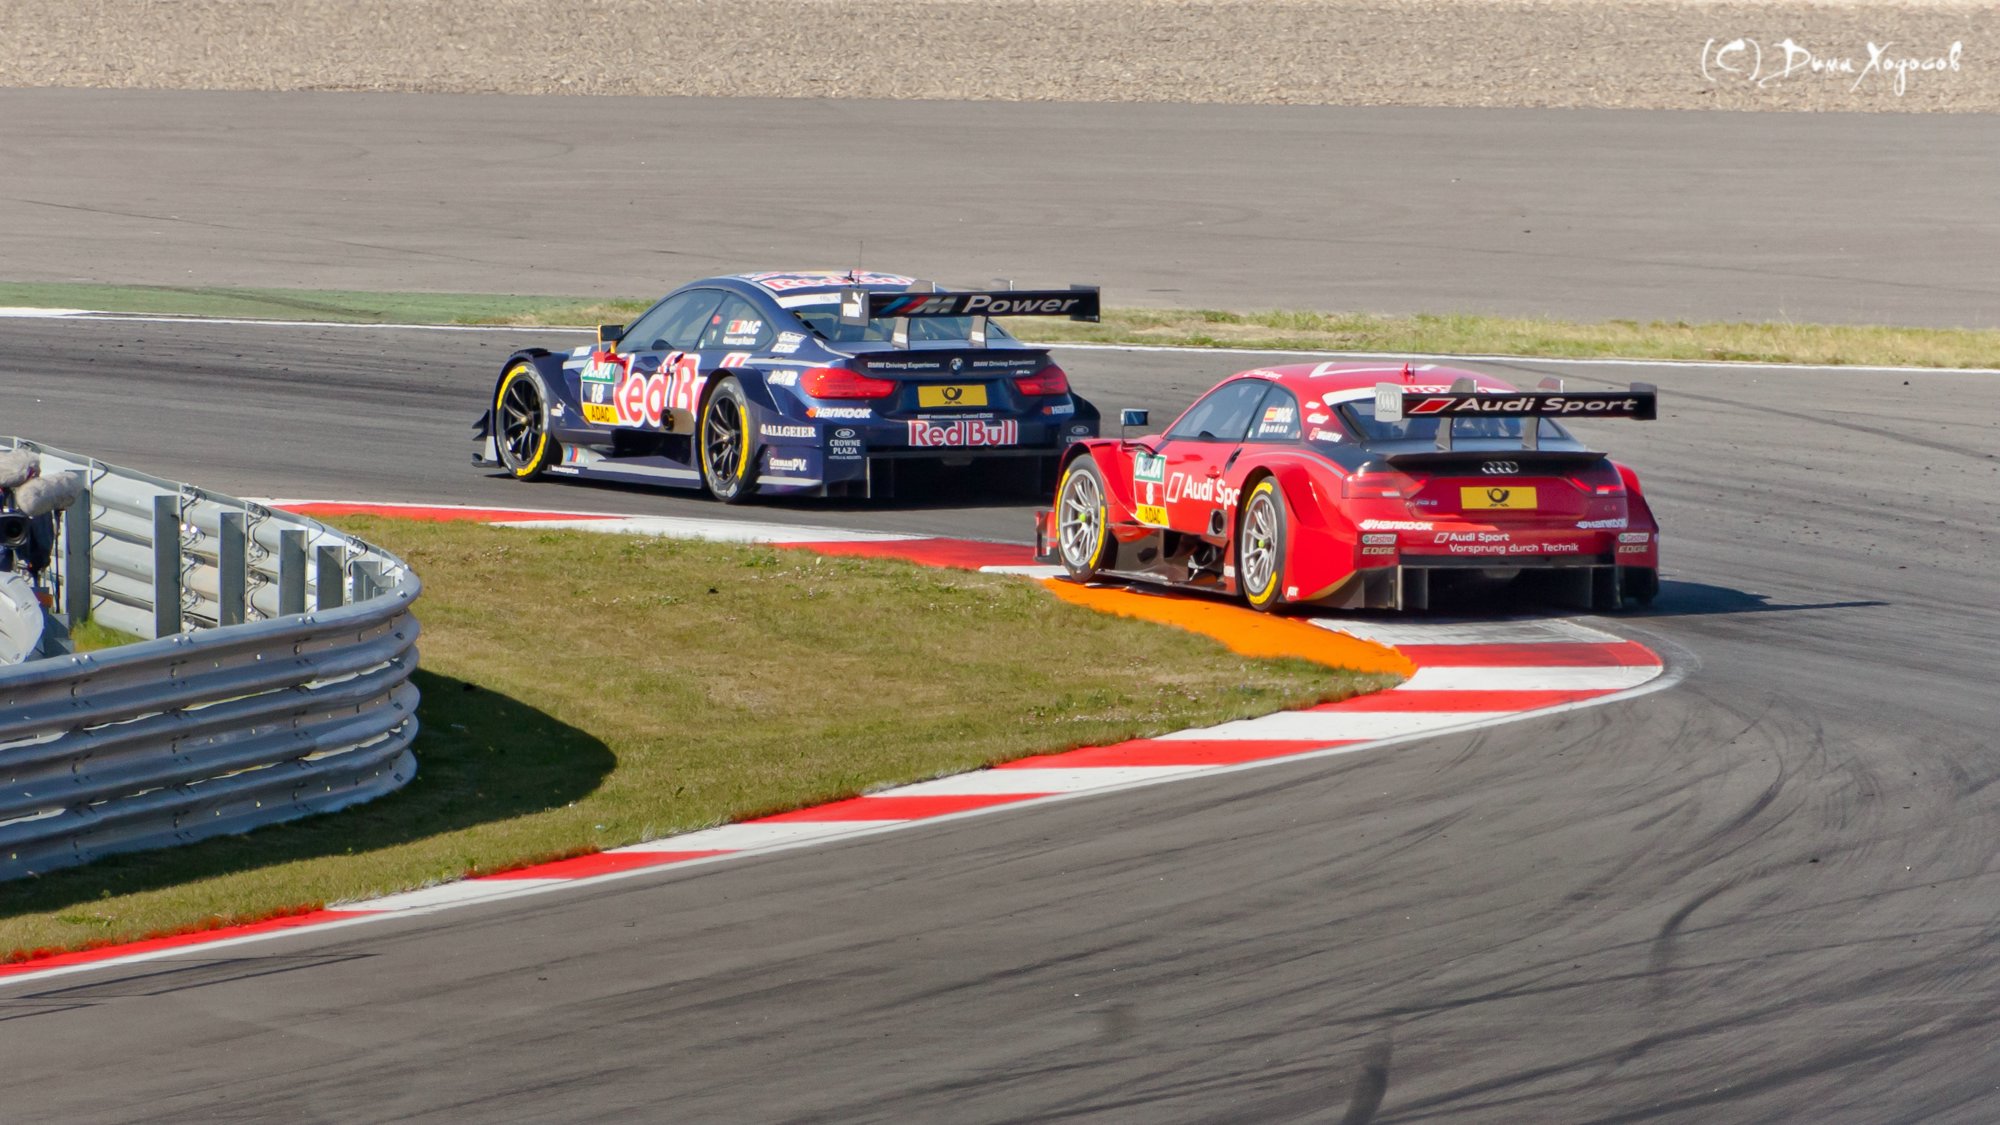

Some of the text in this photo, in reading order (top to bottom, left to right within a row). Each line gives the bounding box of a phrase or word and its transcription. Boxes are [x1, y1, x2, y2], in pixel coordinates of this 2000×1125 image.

[962, 295, 1079, 313] Power
[739, 320, 761, 334] DAC
[907, 361, 940, 369] Experience
[591, 384, 604, 403] 18
[1454, 397, 1638, 413] Audi Sport
[591, 405, 610, 422] ADAC
[766, 424, 816, 437] ALLGEIER
[908, 420, 1018, 446] Red Bull
[829, 439, 861, 447] CROWNE
[833, 447, 857, 455] PLAZA
[1146, 482, 1154, 504] 8
[1182, 475, 1214, 502] Audi
[1449, 532, 1510, 543] Audi Sport
[1362, 547, 1395, 555] EDGE
[1449, 543, 1578, 554] Vorsprung durch Technik
[1618, 545, 1648, 553] EDGE
